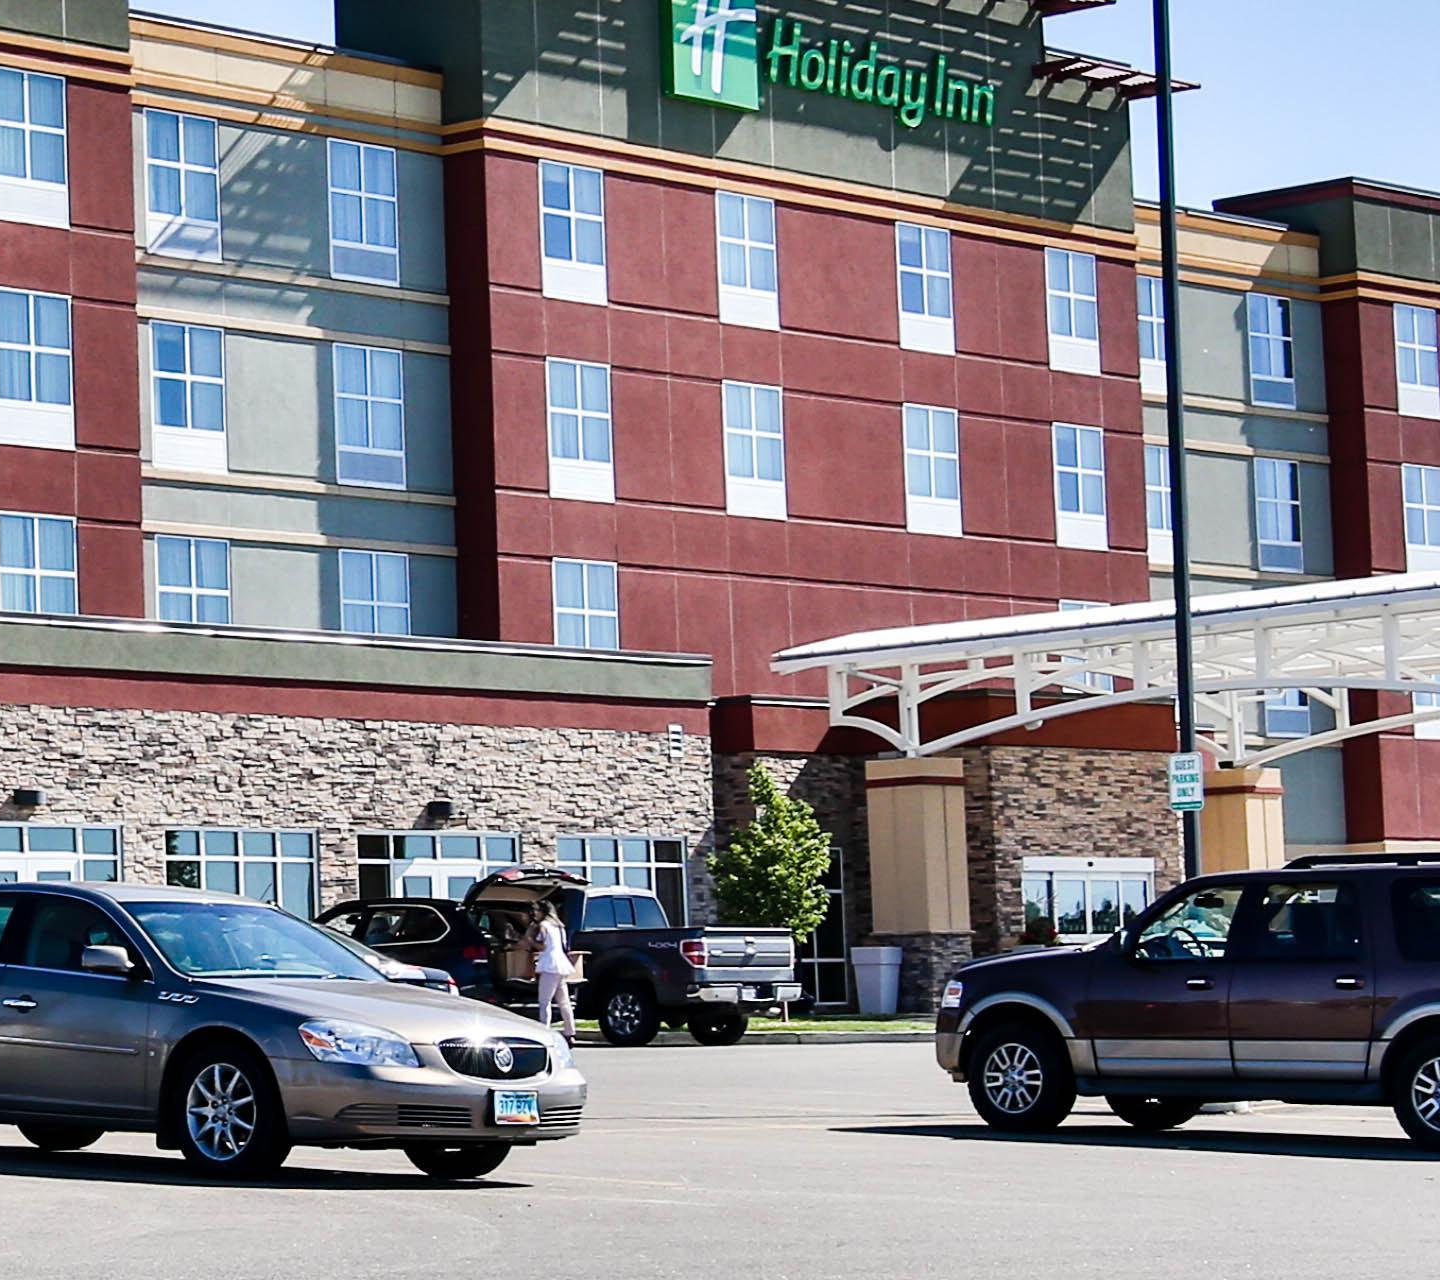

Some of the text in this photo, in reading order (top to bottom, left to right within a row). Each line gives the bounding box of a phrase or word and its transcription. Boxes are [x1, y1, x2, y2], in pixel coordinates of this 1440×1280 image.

[765, 17, 996, 129] Holiday Inn
[1172, 773, 1200, 784] PARKING
[1177, 787, 1195, 798] ONLY
[499, 1099, 514, 1114] 317
